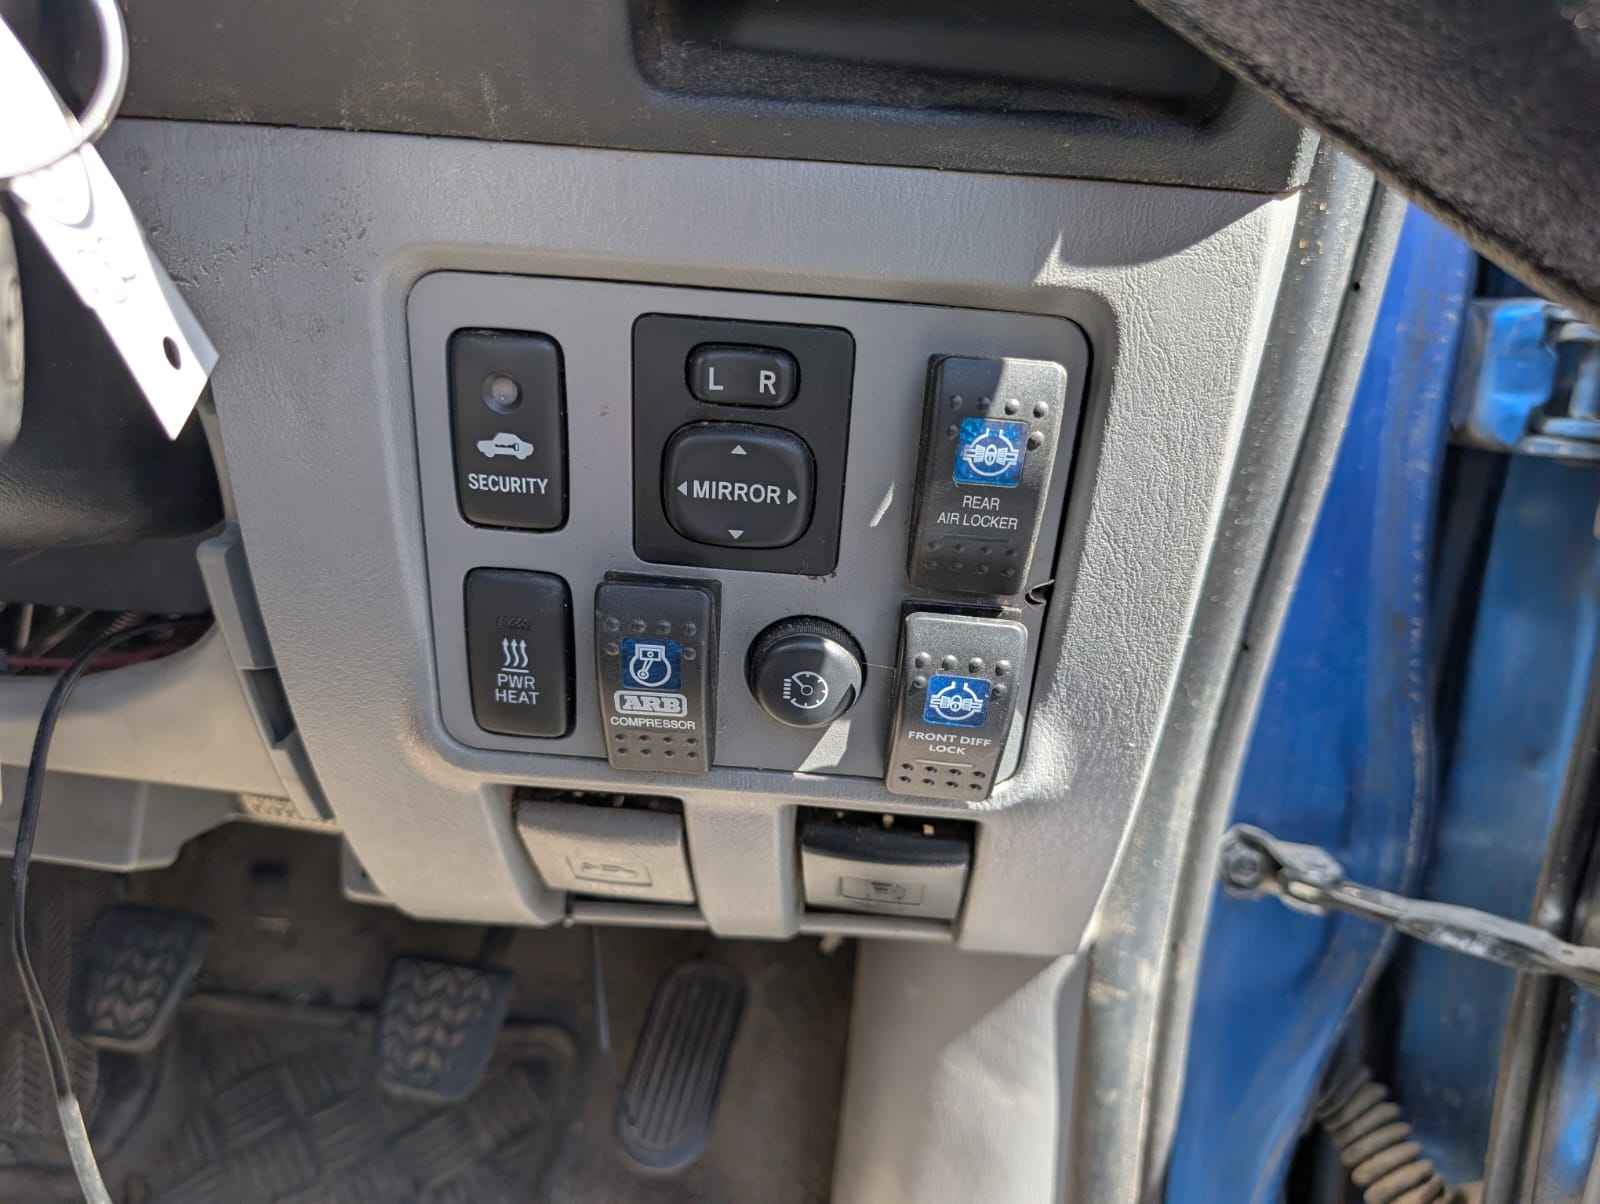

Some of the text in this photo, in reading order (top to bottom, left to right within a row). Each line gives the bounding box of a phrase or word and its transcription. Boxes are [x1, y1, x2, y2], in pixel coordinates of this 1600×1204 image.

[708, 367, 724, 391] L
[759, 370, 776, 395] R
[468, 473, 548, 495] SECURITY
[693, 479, 781, 504] MIRROR
[962, 495, 1000, 510] REAR
[937, 512, 1018, 530] AIR LOCKER
[497, 673, 535, 689] PWR
[495, 688, 539, 705] HEAT
[622, 693, 682, 714] ARB
[610, 716, 696, 730] COMPRESSOR
[908, 731, 991, 746] FRONT DIFF
[928, 743, 966, 755] LOCK
